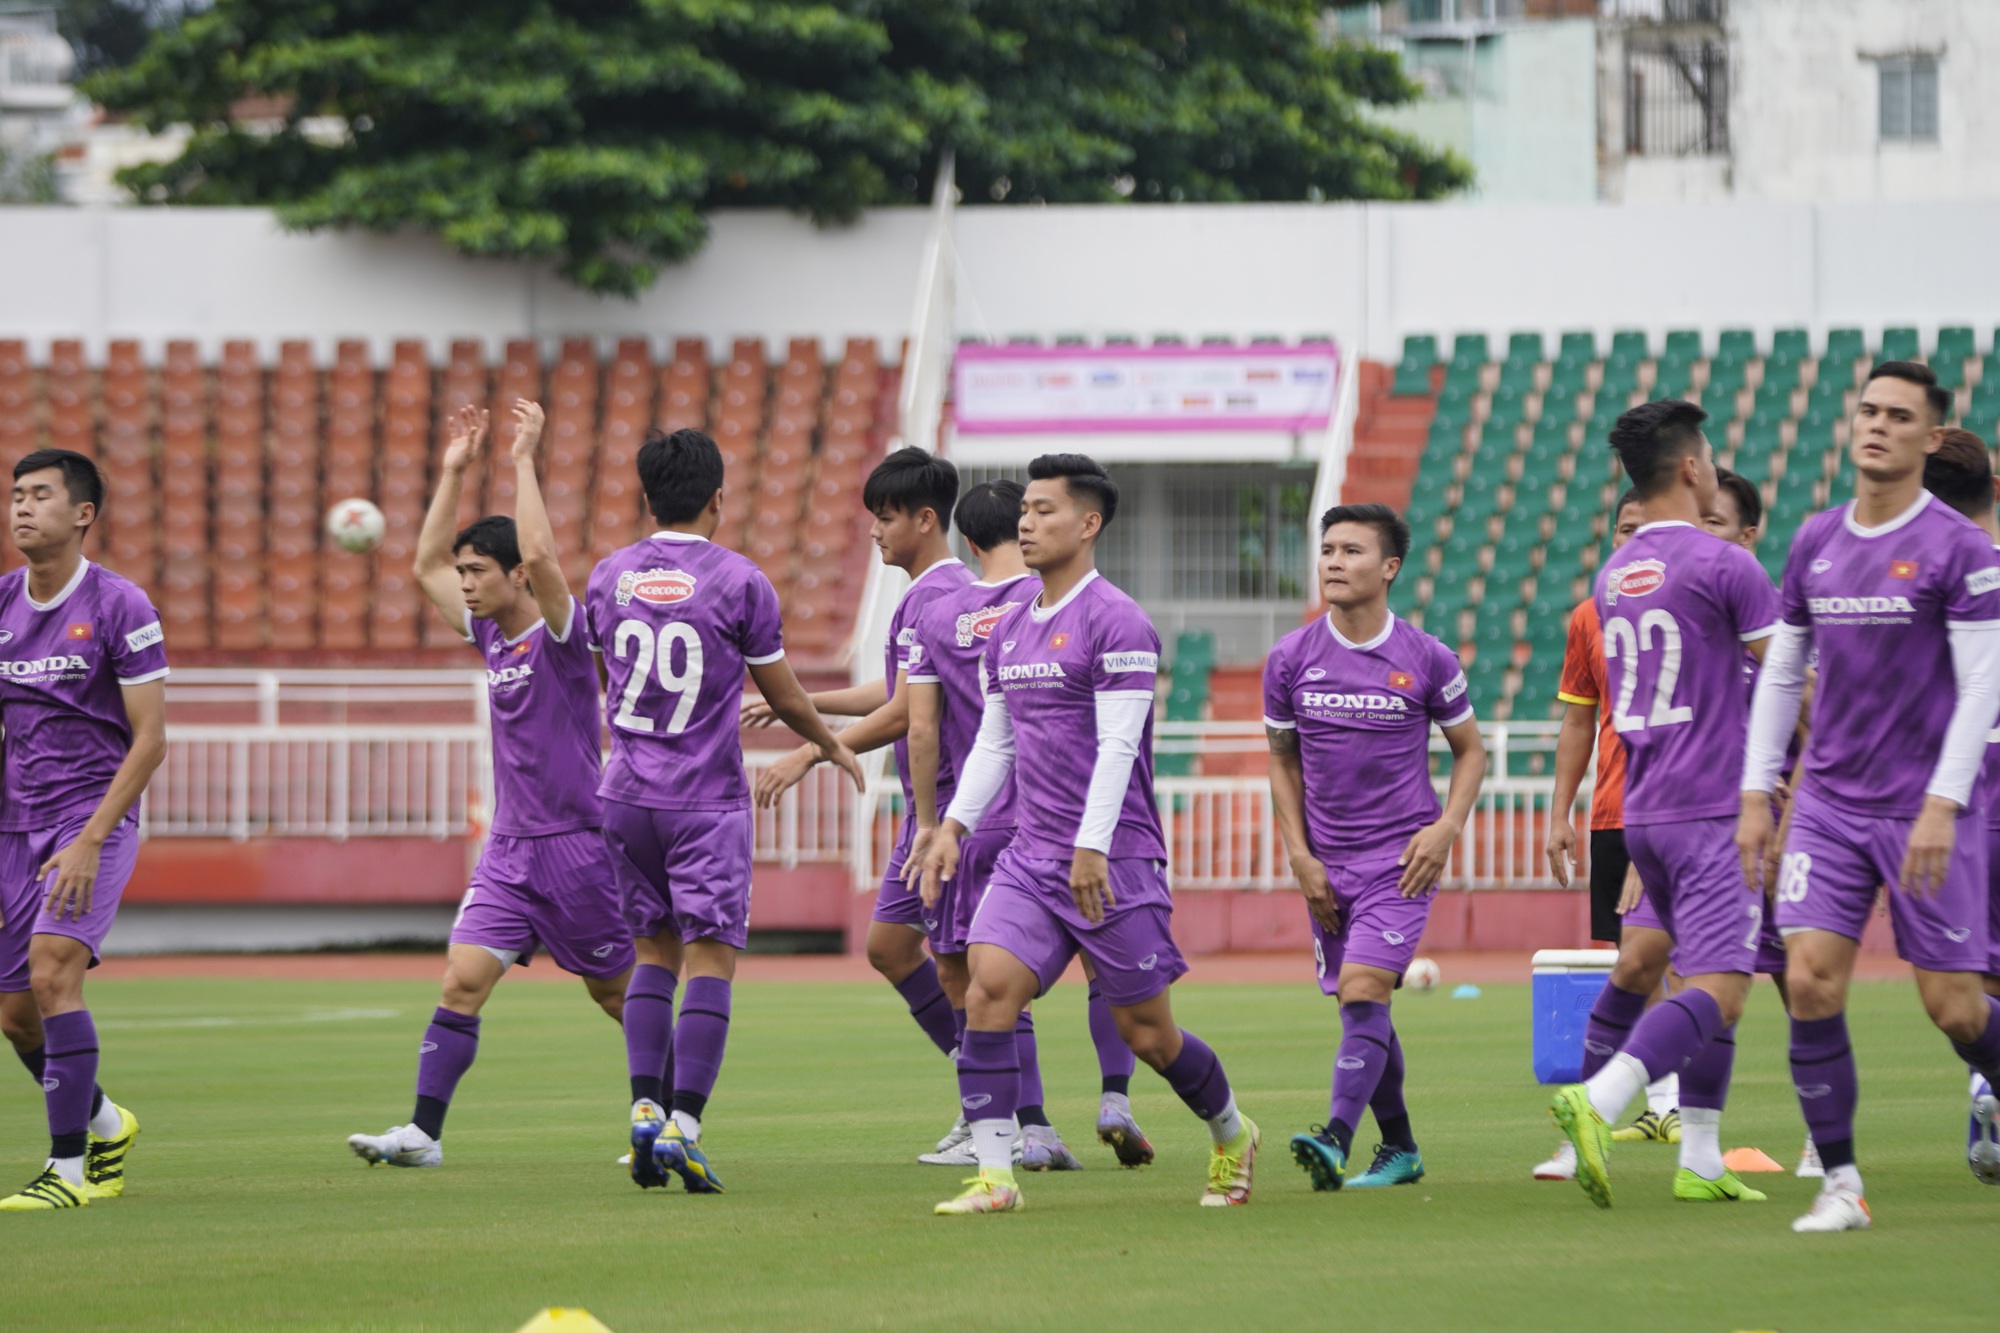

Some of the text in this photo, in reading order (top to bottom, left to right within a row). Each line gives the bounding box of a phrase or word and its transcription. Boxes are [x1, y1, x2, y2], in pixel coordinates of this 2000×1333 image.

[1807, 596, 1917, 613] HONDA
[0, 655, 91, 676] HONDA
[998, 662, 1067, 681] HONDA
[1604, 608, 1693, 732] 22
[50, 673, 87, 681] Dreams
[613, 619, 704, 734] 29
[1302, 691, 1409, 711] HONDA
[1305, 708, 1406, 720] The Power of Dreams
